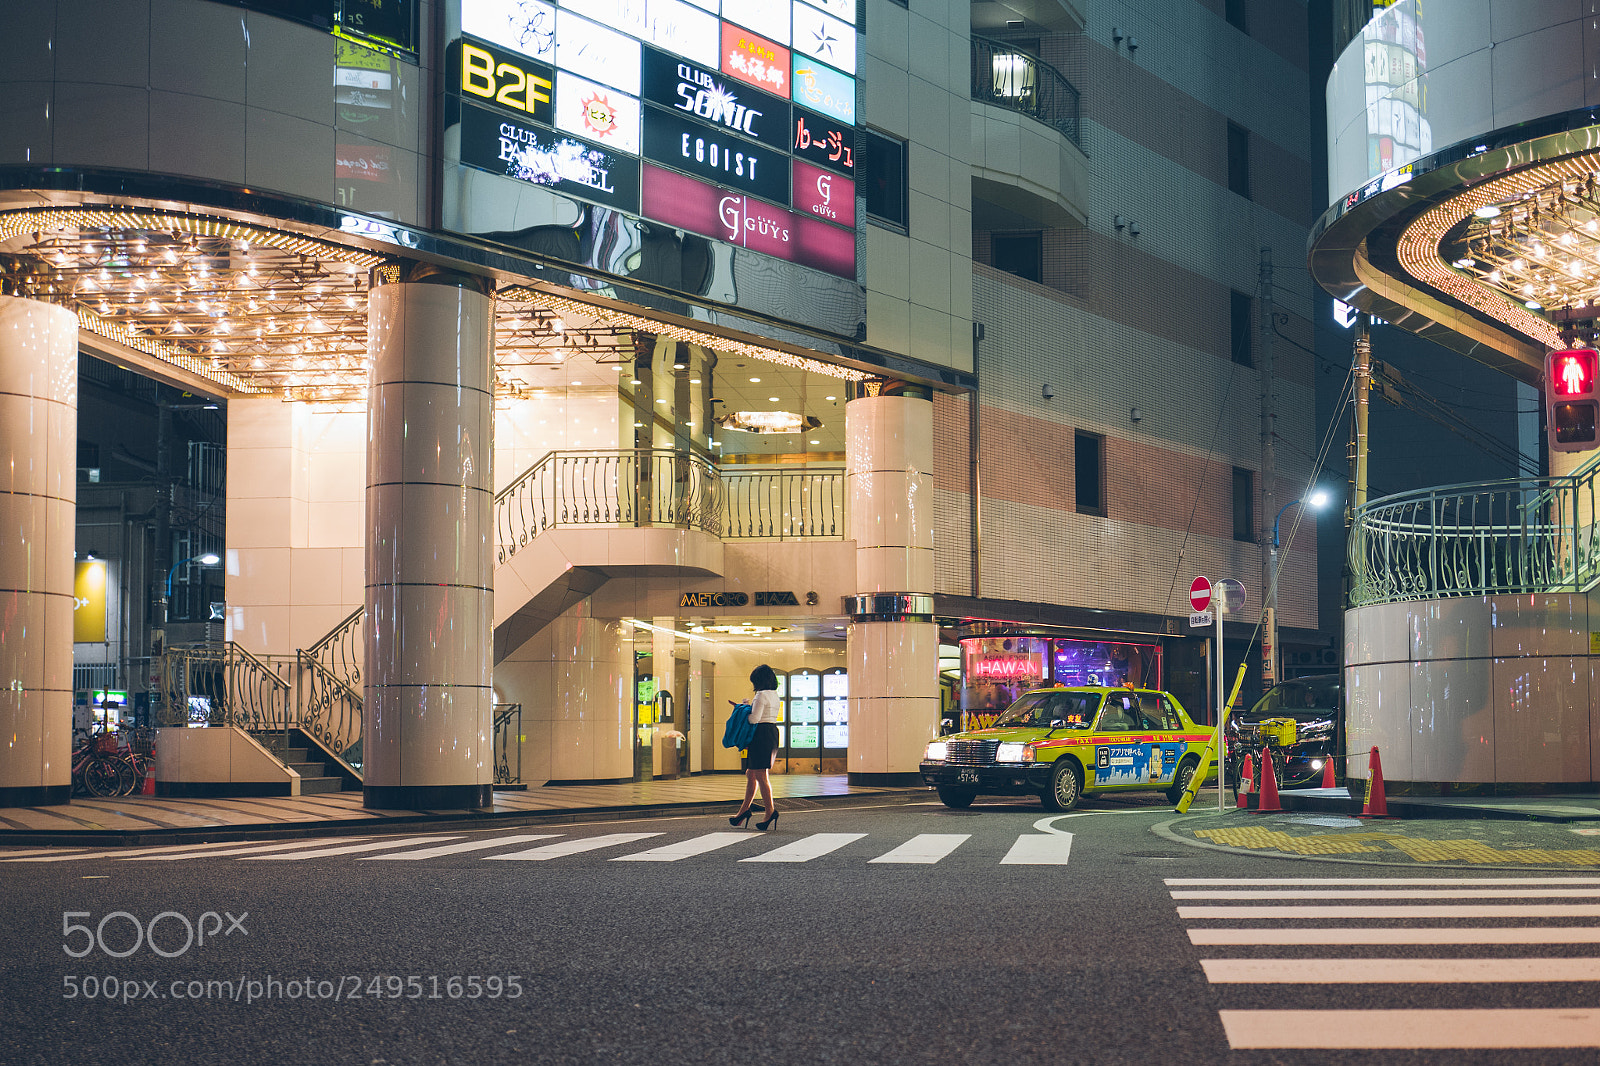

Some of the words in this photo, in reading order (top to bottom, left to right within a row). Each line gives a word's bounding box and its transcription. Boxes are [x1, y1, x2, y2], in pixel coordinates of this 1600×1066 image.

[462, 43, 552, 114] B2F
[677, 63, 713, 89] CLUB
[674, 82, 763, 137] SONIC
[499, 123, 538, 146] CLUB
[794, 117, 854, 168] ルージュ
[681, 132, 758, 181] EGOIST
[754, 591, 801, 606] PLAZA
[976, 661, 1038, 675] IHAWAN
